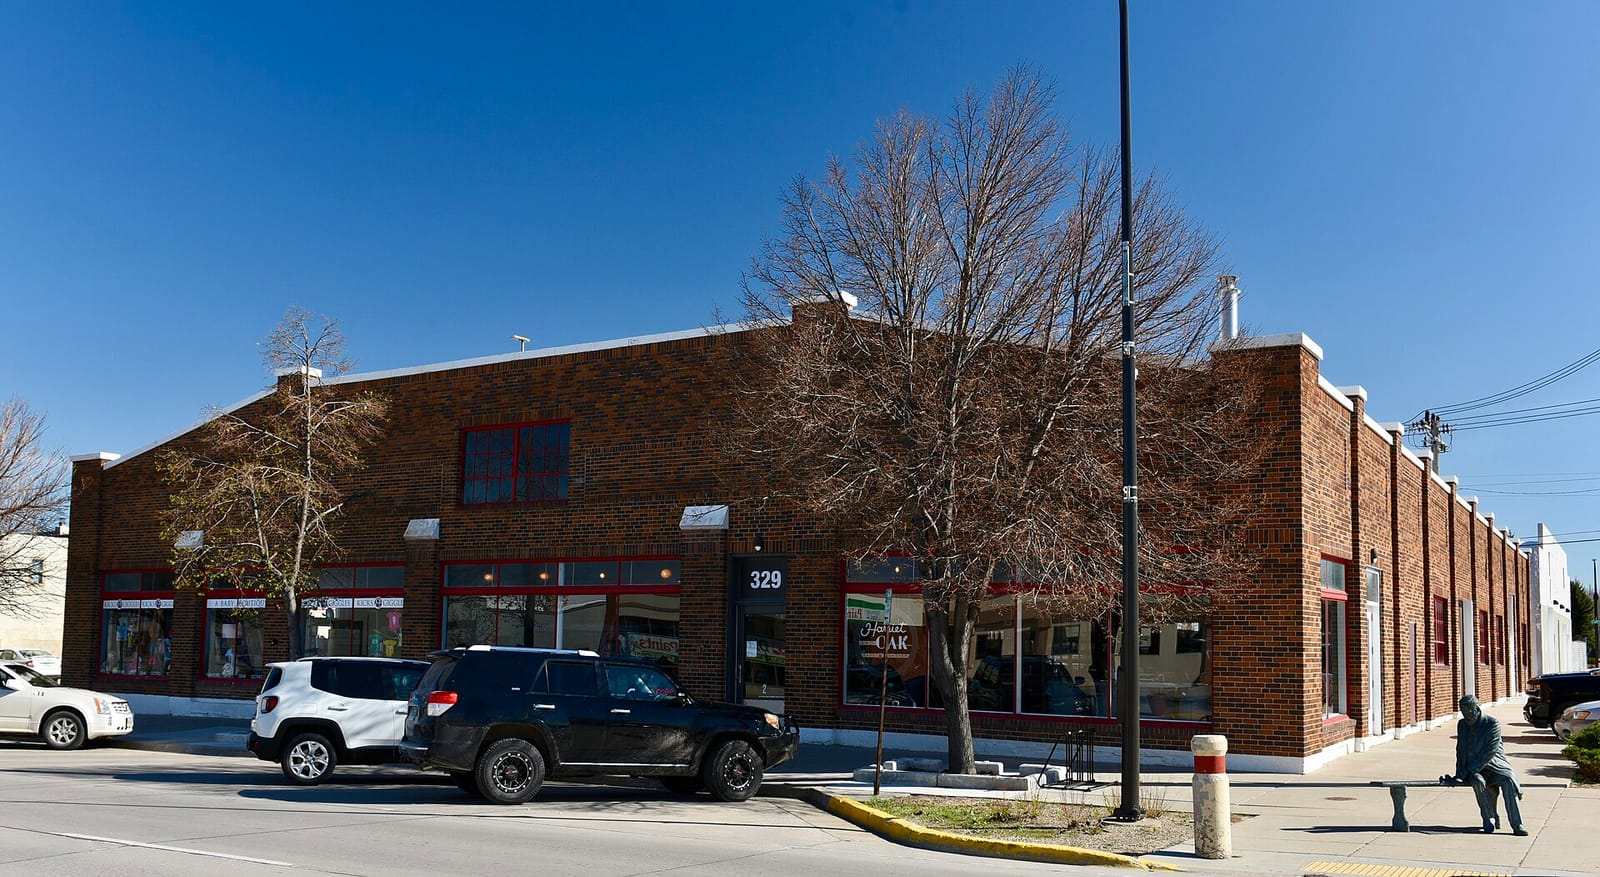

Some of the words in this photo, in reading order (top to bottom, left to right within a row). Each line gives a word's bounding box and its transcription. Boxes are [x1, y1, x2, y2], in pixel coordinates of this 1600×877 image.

[750, 570, 782, 589] 329
[875, 635, 908, 650] OAK
[762, 684, 767, 694] 2
